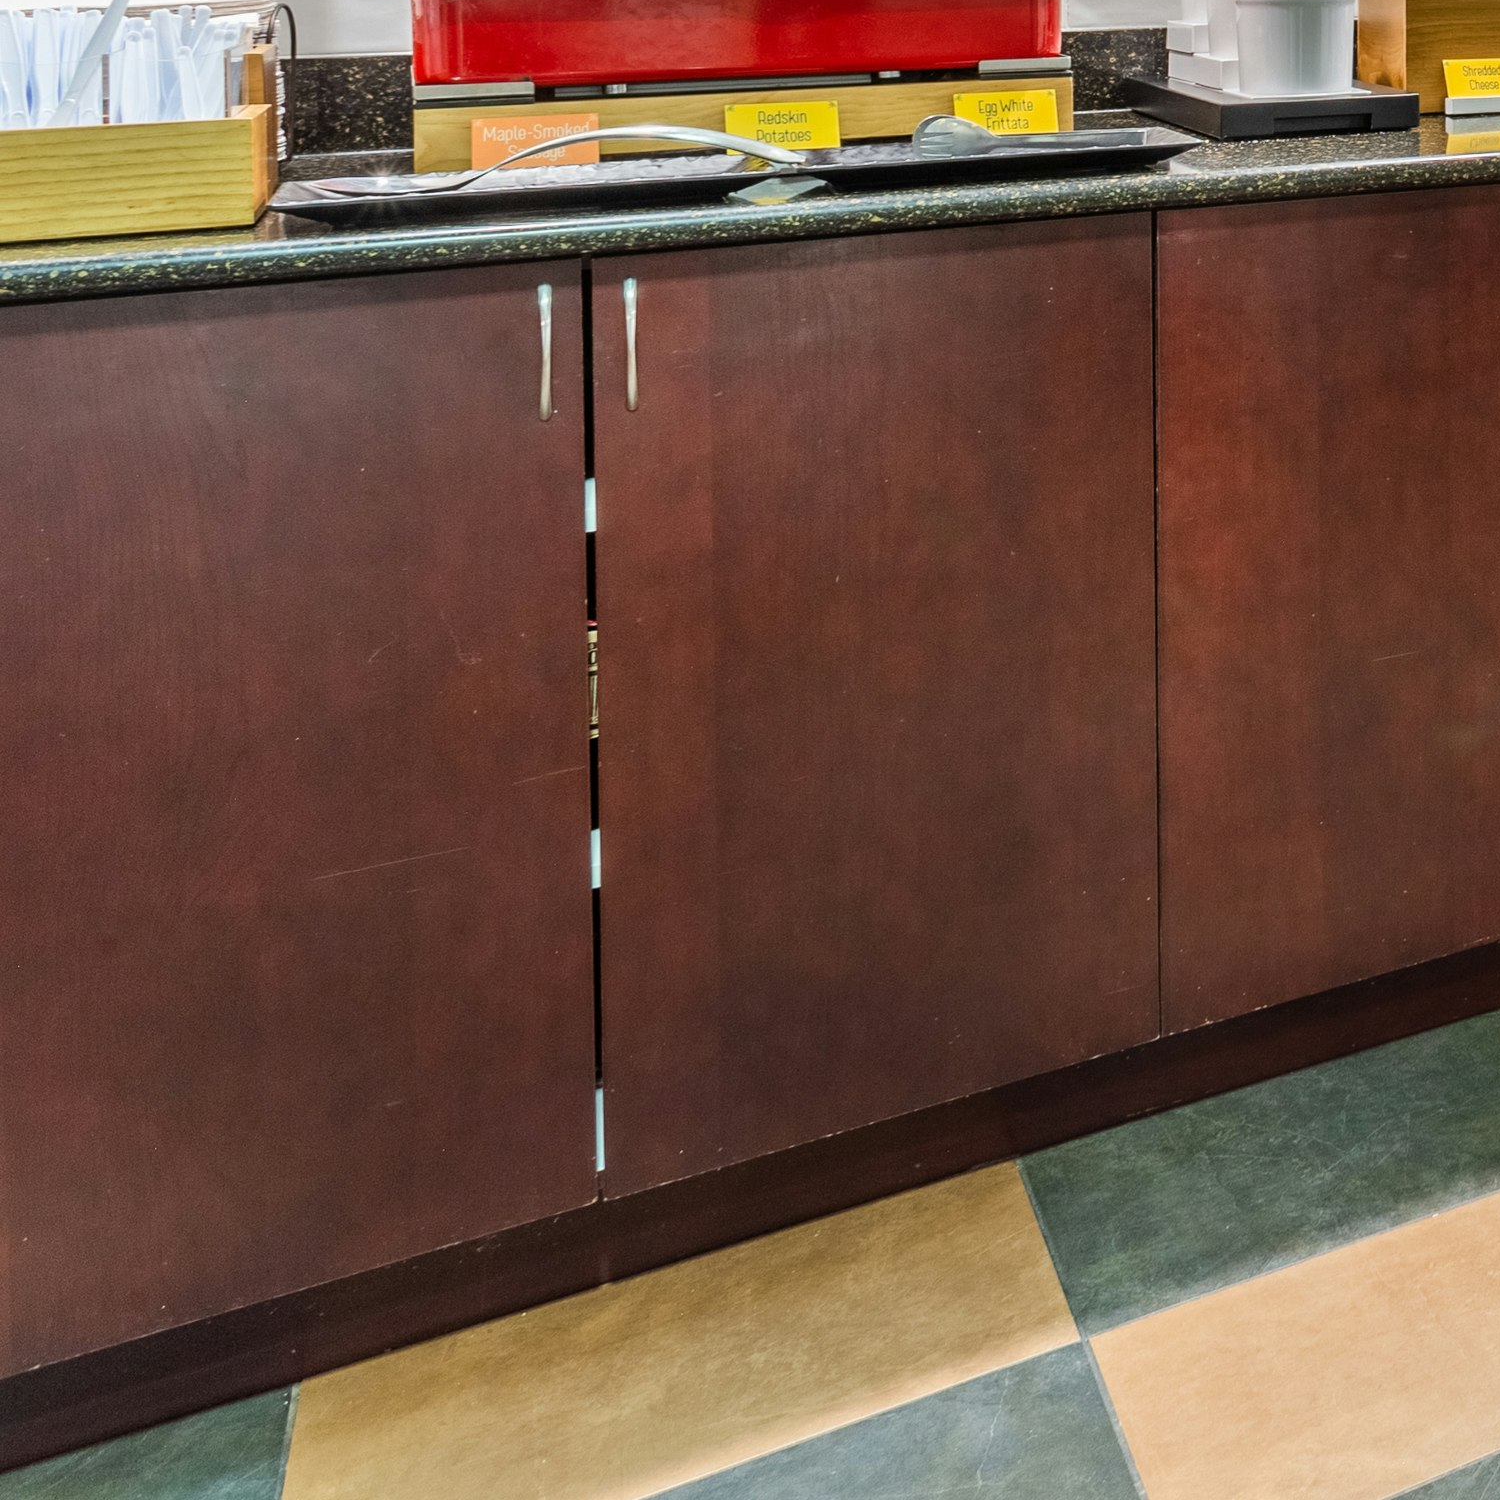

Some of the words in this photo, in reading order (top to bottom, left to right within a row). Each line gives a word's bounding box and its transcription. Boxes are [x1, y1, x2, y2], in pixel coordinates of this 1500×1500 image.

[1469, 79, 1500, 90] Cheese
[978, 100, 997, 116] Egg
[1000, 99, 1034, 112] White
[757, 110, 808, 125] Redskin
[986, 117, 1029, 130] Frittata
[483, 121, 590, 145] Maple-Smoked
[756, 129, 812, 143] Potatoes
